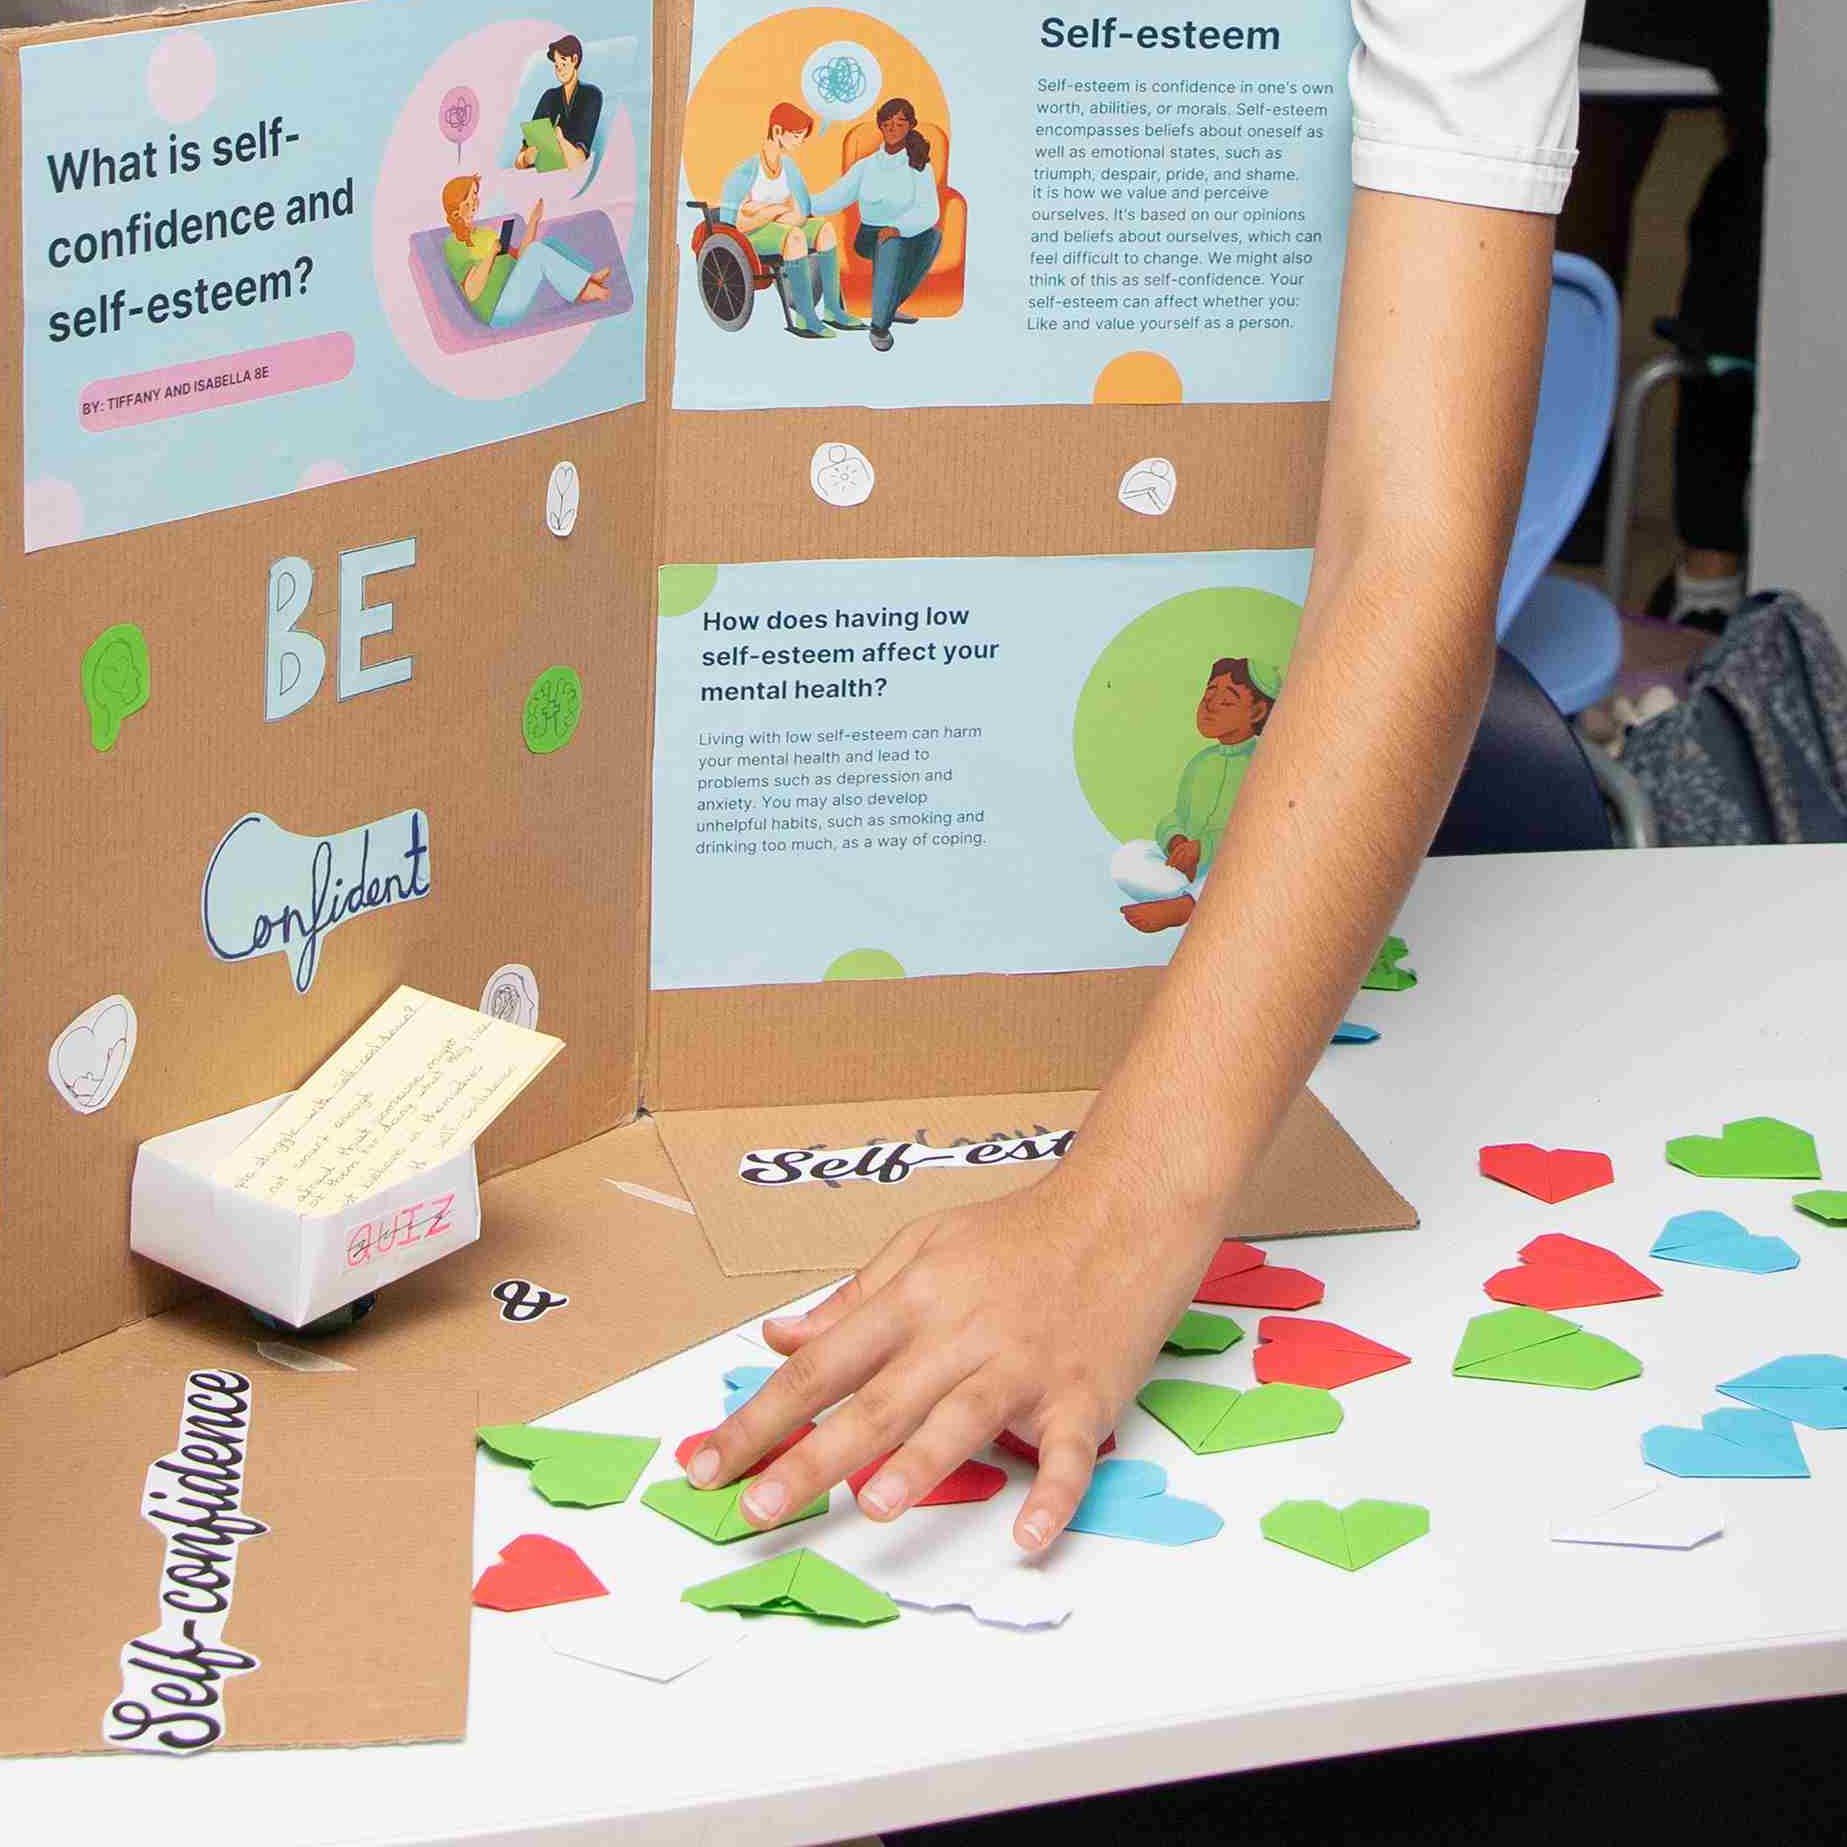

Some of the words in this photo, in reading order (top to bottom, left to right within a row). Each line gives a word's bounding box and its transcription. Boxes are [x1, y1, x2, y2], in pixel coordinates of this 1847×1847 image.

[1041, 17, 1280, 50] Self-esteem
[1037, 78, 1130, 93] Self-esteem
[1136, 79, 1146, 93] is
[1152, 79, 1235, 94] confidence
[1240, 80, 1253, 94] in
[1258, 80, 1297, 95] one's
[1302, 84, 1333, 95] own
[1037, 102, 1084, 117] worth,
[1089, 101, 1151, 117] abilities,
[1156, 104, 1172, 115] or
[1177, 102, 1231, 116] morals.
[1236, 103, 1328, 117] Self-esteem
[1036, 126, 1139, 139] encompasses
[1145, 123, 1194, 138] beliefs
[1200, 124, 1242, 138] about
[1248, 124, 1302, 138] oneself
[1307, 128, 1324, 138] as
[47, 142, 158, 194] What
[169, 131, 201, 177] is
[213, 115, 300, 168] self-
[1035, 146, 1064, 159] well
[1070, 148, 1086, 159] as
[1091, 145, 1165, 159] emotional
[1170, 146, 1220, 161] states,
[1225, 146, 1260, 160] such
[1266, 149, 1282, 160] as
[1034, 168, 1096, 182] triumph,
[1102, 168, 1160, 182] despair,
[1166, 168, 1208, 182] pride,
[1214, 169, 1241, 181] and
[1246, 169, 1299, 182] shame.
[1032, 187, 1042, 199] it
[1046, 187, 1059, 199] is
[1063, 186, 1096, 199] how
[1101, 189, 1122, 199] we
[1127, 187, 1167, 199] value
[1172, 186, 1199, 199] and
[1204, 187, 1269, 202] perceive
[48, 202, 275, 269] confidence
[285, 177, 355, 226] and
[1032, 209, 1108, 221] ourselves.
[1114, 208, 1135, 221] It's
[1141, 208, 1186, 221] based
[1191, 211, 1209, 221] on
[1214, 211, 1238, 221] our
[1243, 209, 1305, 224] opinions
[1031, 230, 1058, 243] and
[1063, 230, 1114, 243] beliefs
[1118, 231, 1161, 243] about
[1166, 230, 1242, 245] ourselves,
[1248, 230, 1291, 243] which
[1295, 232, 1322, 243] can
[1030, 252, 1057, 265] feel
[1063, 252, 1119, 265] difficult
[1124, 253, 1139, 265] to
[1144, 252, 1203, 268] change.
[1208, 252, 1232, 265] We
[1236, 252, 1277, 267] might
[1283, 252, 1312, 264] also
[1029, 273, 1065, 287] think
[1070, 273, 1086, 287] of
[1091, 273, 1117, 286] this
[1122, 276, 1139, 286] as
[1144, 273, 1264, 286] self-confidence.
[1270, 273, 1303, 286] Your
[48, 255, 314, 343] self-esteem?
[1028, 295, 1118, 309] self-esteem
[1123, 298, 1149, 308] can
[1154, 294, 1198, 308] affect
[1203, 294, 1264, 308] whether
[1027, 317, 1057, 330] Like
[1063, 317, 1090, 330] and
[1096, 317, 1135, 330] value
[1140, 317, 1199, 332] yourself
[1204, 319, 1221, 329] as
[1226, 319, 1234, 329] a
[1239, 318, 1293, 332] person.
[83, 399, 104, 417] BY:
[107, 386, 161, 409] TIFFANY
[164, 380, 191, 398] AND
[194, 369, 252, 391] ISABELLA
[255, 365, 270, 379] 8E
[264, 537, 416, 723] BE
[703, 611, 759, 631] How
[767, 610, 828, 630] does
[835, 607, 919, 631] having
[926, 606, 969, 626] low
[702, 646, 854, 666] self-esteem
[862, 642, 936, 662] affect
[943, 642, 999, 664] your
[701, 680, 787, 701] mental
[795, 678, 888, 699] health?
[699, 733, 744, 748] Living
[749, 731, 781, 744] with
[786, 731, 811, 743] low
[817, 727, 907, 743] self-esteem
[912, 728, 939, 739] can
[943, 726, 982, 738] harm
[698, 755, 732, 770] your
[737, 753, 788, 767] mental
[793, 751, 840, 765] health
[845, 750, 873, 763] and
[878, 749, 910, 762] lead
[915, 749, 930, 761] to
[697, 776, 769, 792] problems
[774, 773, 810, 787] such
[815, 774, 832, 786] as
[837, 770, 920, 787] depression
[925, 769, 953, 782] and
[697, 797, 756, 812] anxiety.
[763, 796, 791, 809] You
[796, 797, 828, 810] may
[832, 794, 863, 806] also
[867, 792, 928, 807] develop
[696, 818, 767, 833] unhelpful
[772, 815, 822, 831] habits,
[827, 815, 862, 828] such
[867, 816, 885, 826] as
[889, 812, 952, 827] smoking
[957, 810, 984, 823] and
[696, 840, 757, 856] drinking
[762, 839, 786, 852] too
[792, 837, 837, 852] much,
[842, 838, 859, 849] as
[864, 838, 873, 848] a
[878, 835, 908, 849] way
[912, 833, 928, 846] of
[932, 832, 986, 847] coping.
[203, 812, 430, 992] Confident
[740, 1130, 1078, 1184] Self-est
[345, 1191, 456, 1268] QUIZ
[493, 1280, 567, 1320] &
[109, 1369, 269, 1749] Self-confidence
